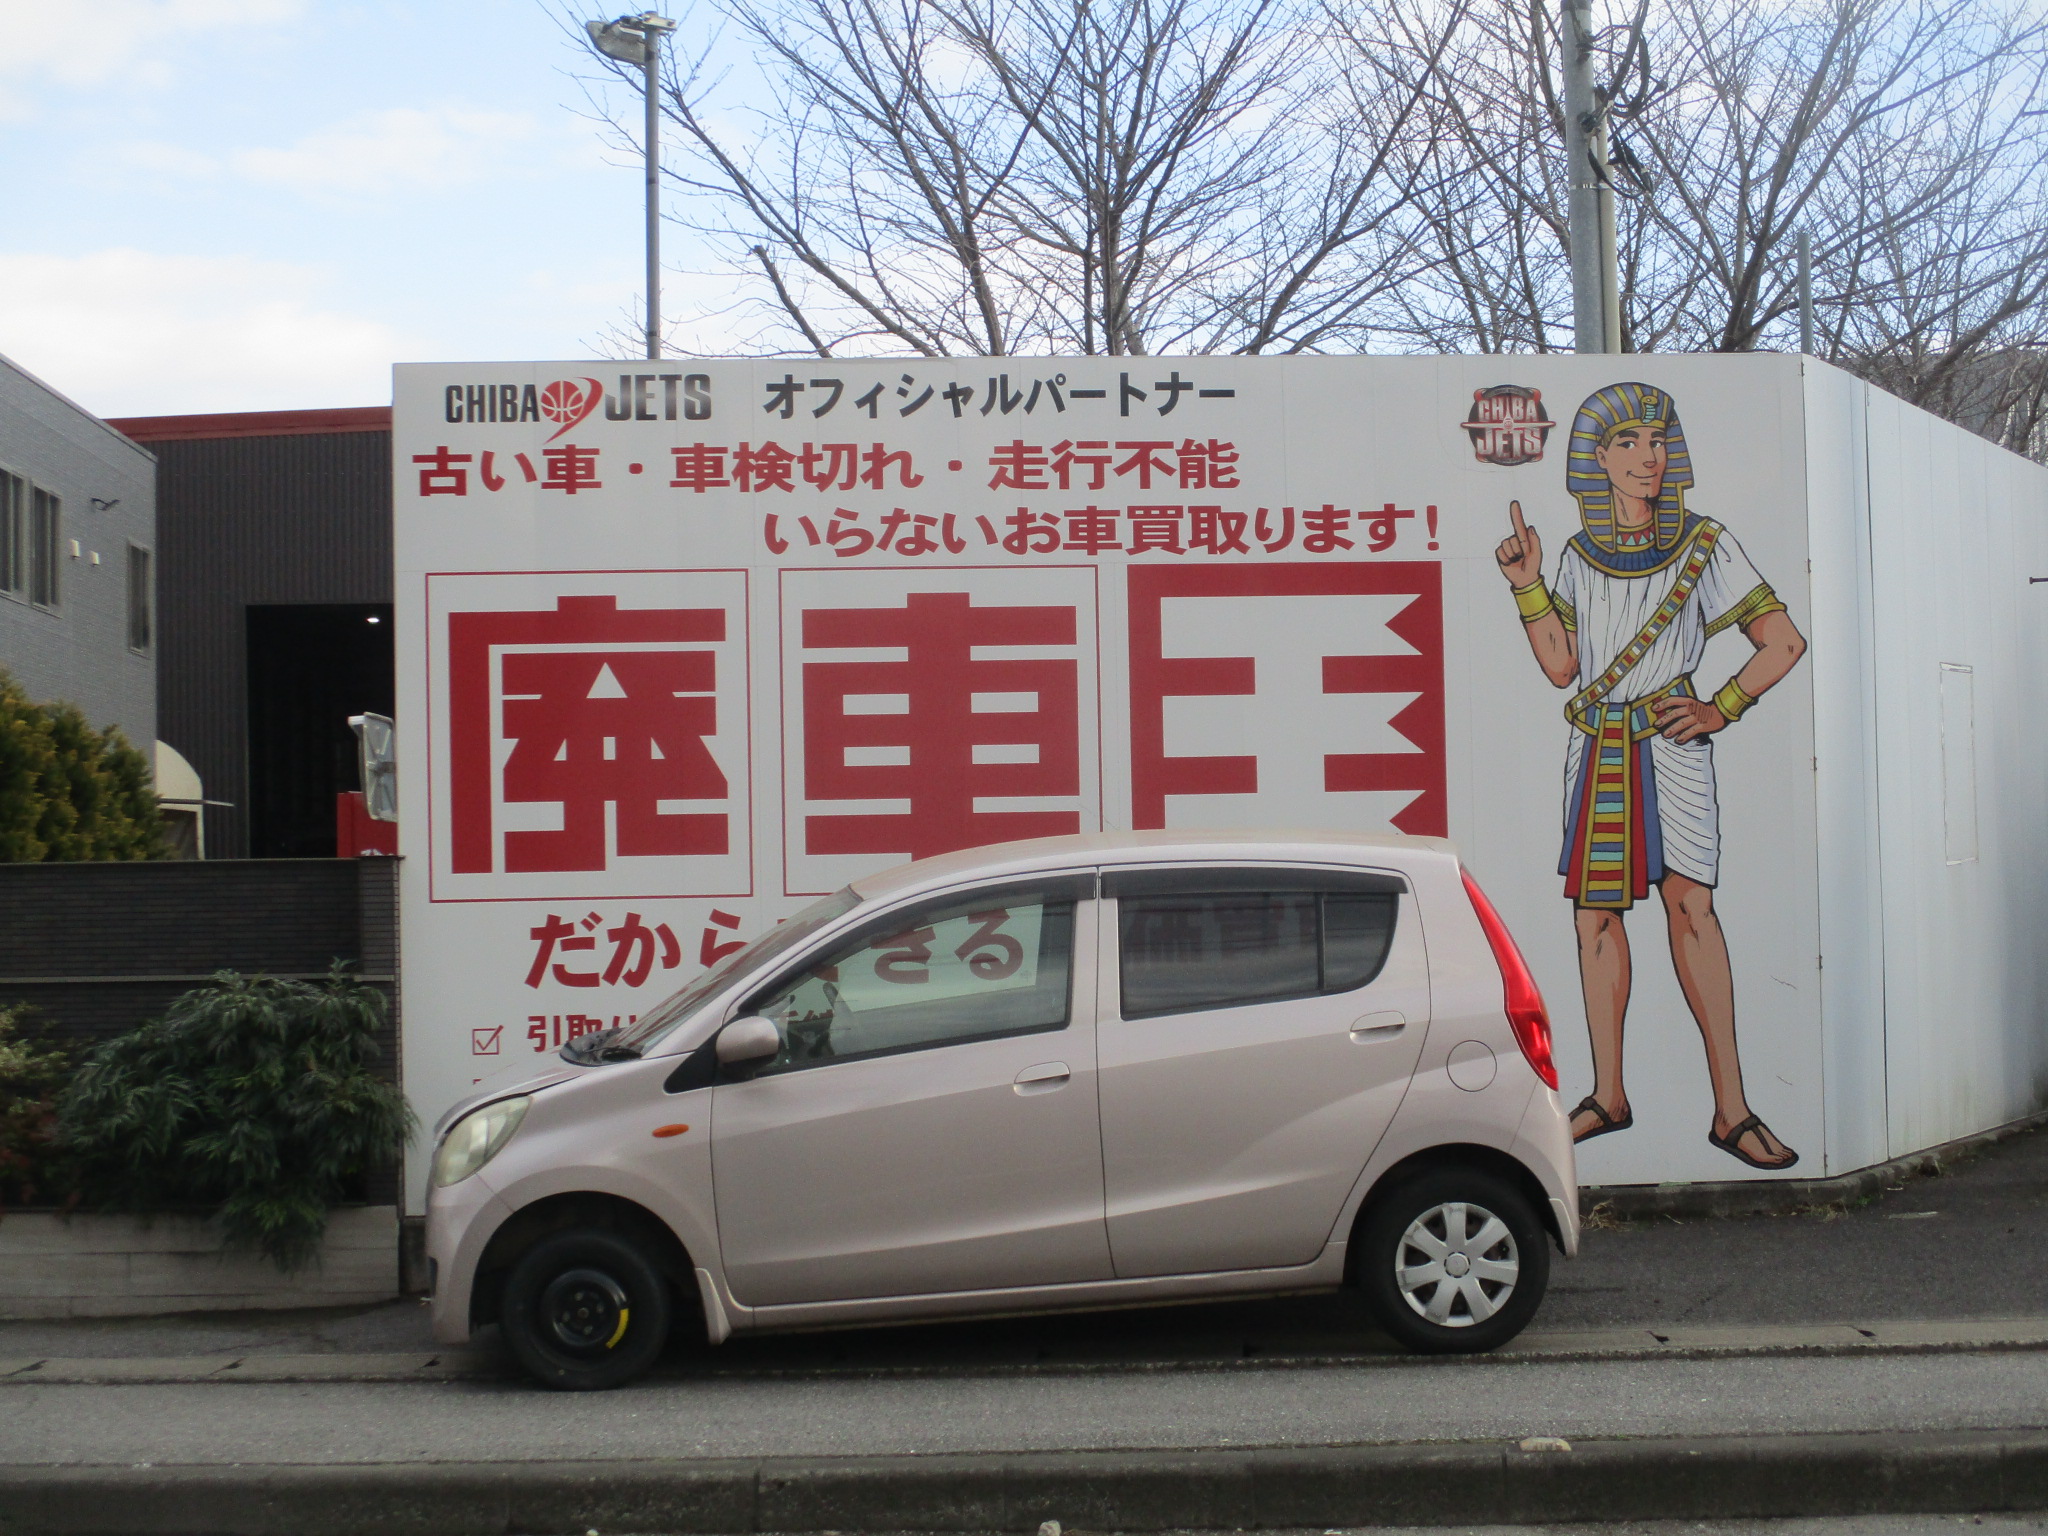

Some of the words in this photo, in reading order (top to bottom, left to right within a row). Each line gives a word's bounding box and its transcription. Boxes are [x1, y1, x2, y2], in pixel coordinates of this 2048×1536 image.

[445, 384, 540, 423] CHIBA
[604, 374, 712, 421] JETS
[762, 371, 1236, 420] オフィシャルパートナー
[1477, 396, 1538, 422] CHIBA
[1475, 427, 1541, 459] JETS
